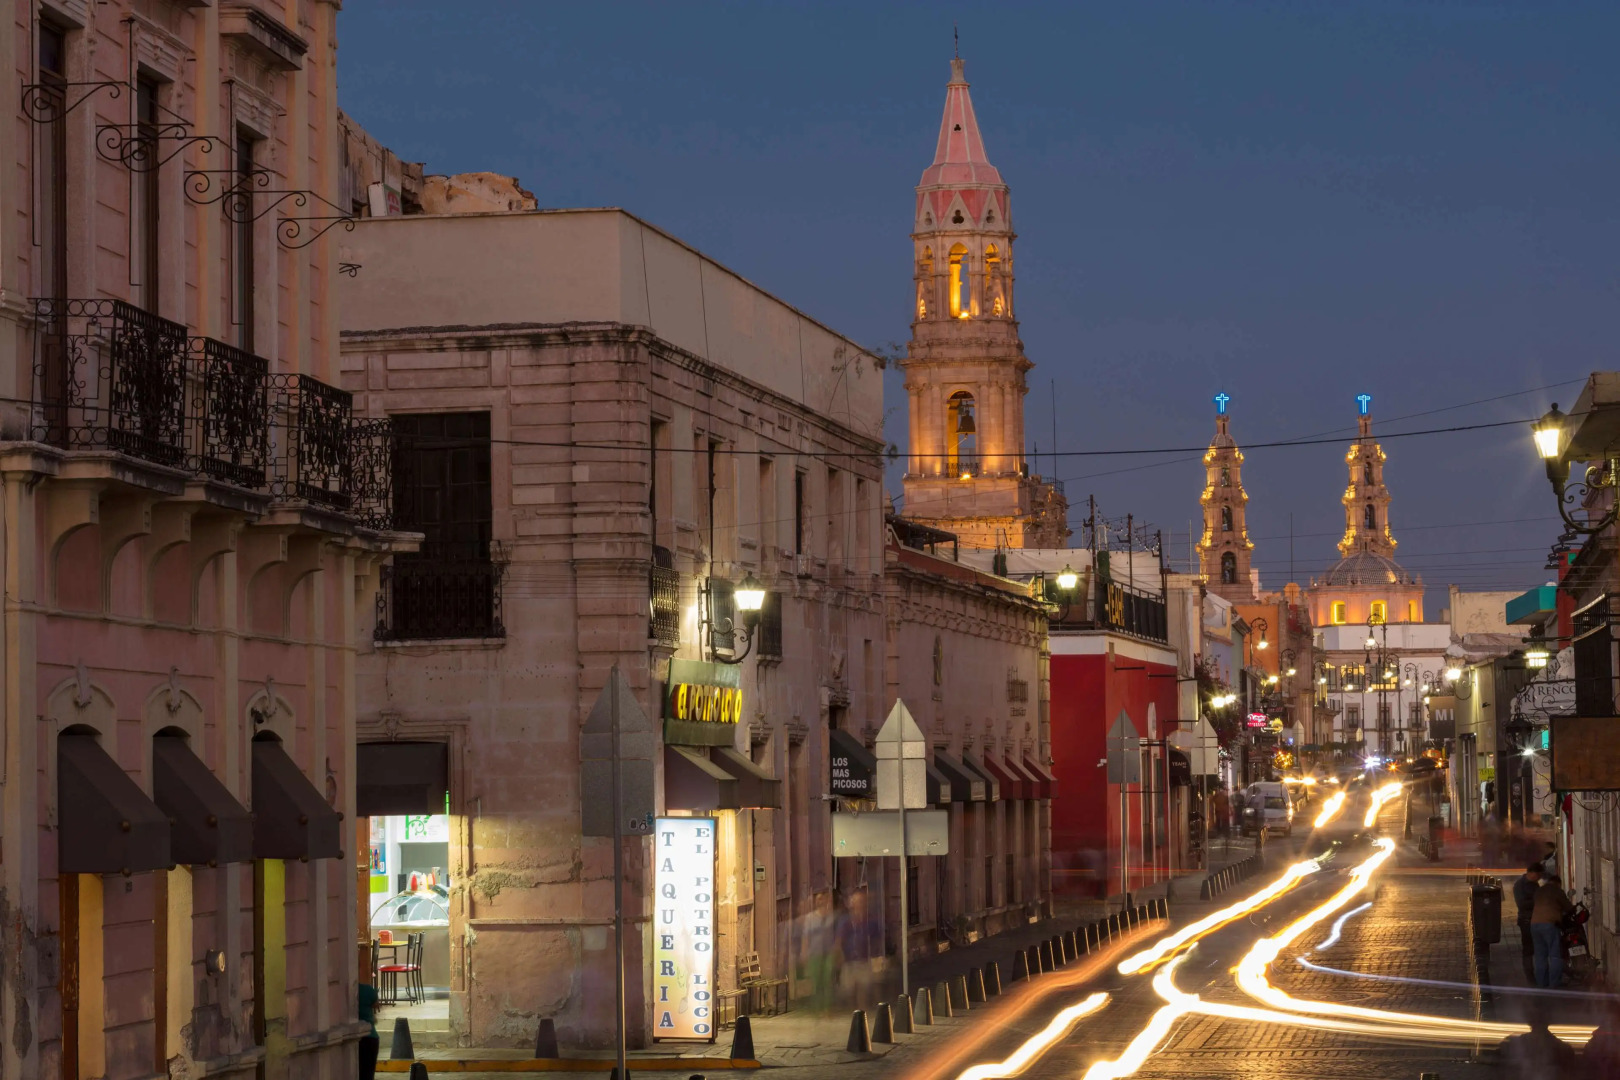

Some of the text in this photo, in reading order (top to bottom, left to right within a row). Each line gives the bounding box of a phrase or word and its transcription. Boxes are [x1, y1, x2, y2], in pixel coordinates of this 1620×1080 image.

[688, 683, 721, 722] POTRO
[721, 686, 743, 724] LOCO
[832, 757, 849, 767] LOS
[832, 768, 850, 778] MAS
[832, 779, 868, 789] PICOSOS
[660, 831, 677, 1028] TAQUERIA
[693, 827, 712, 1034] EL POTRO LOCO
